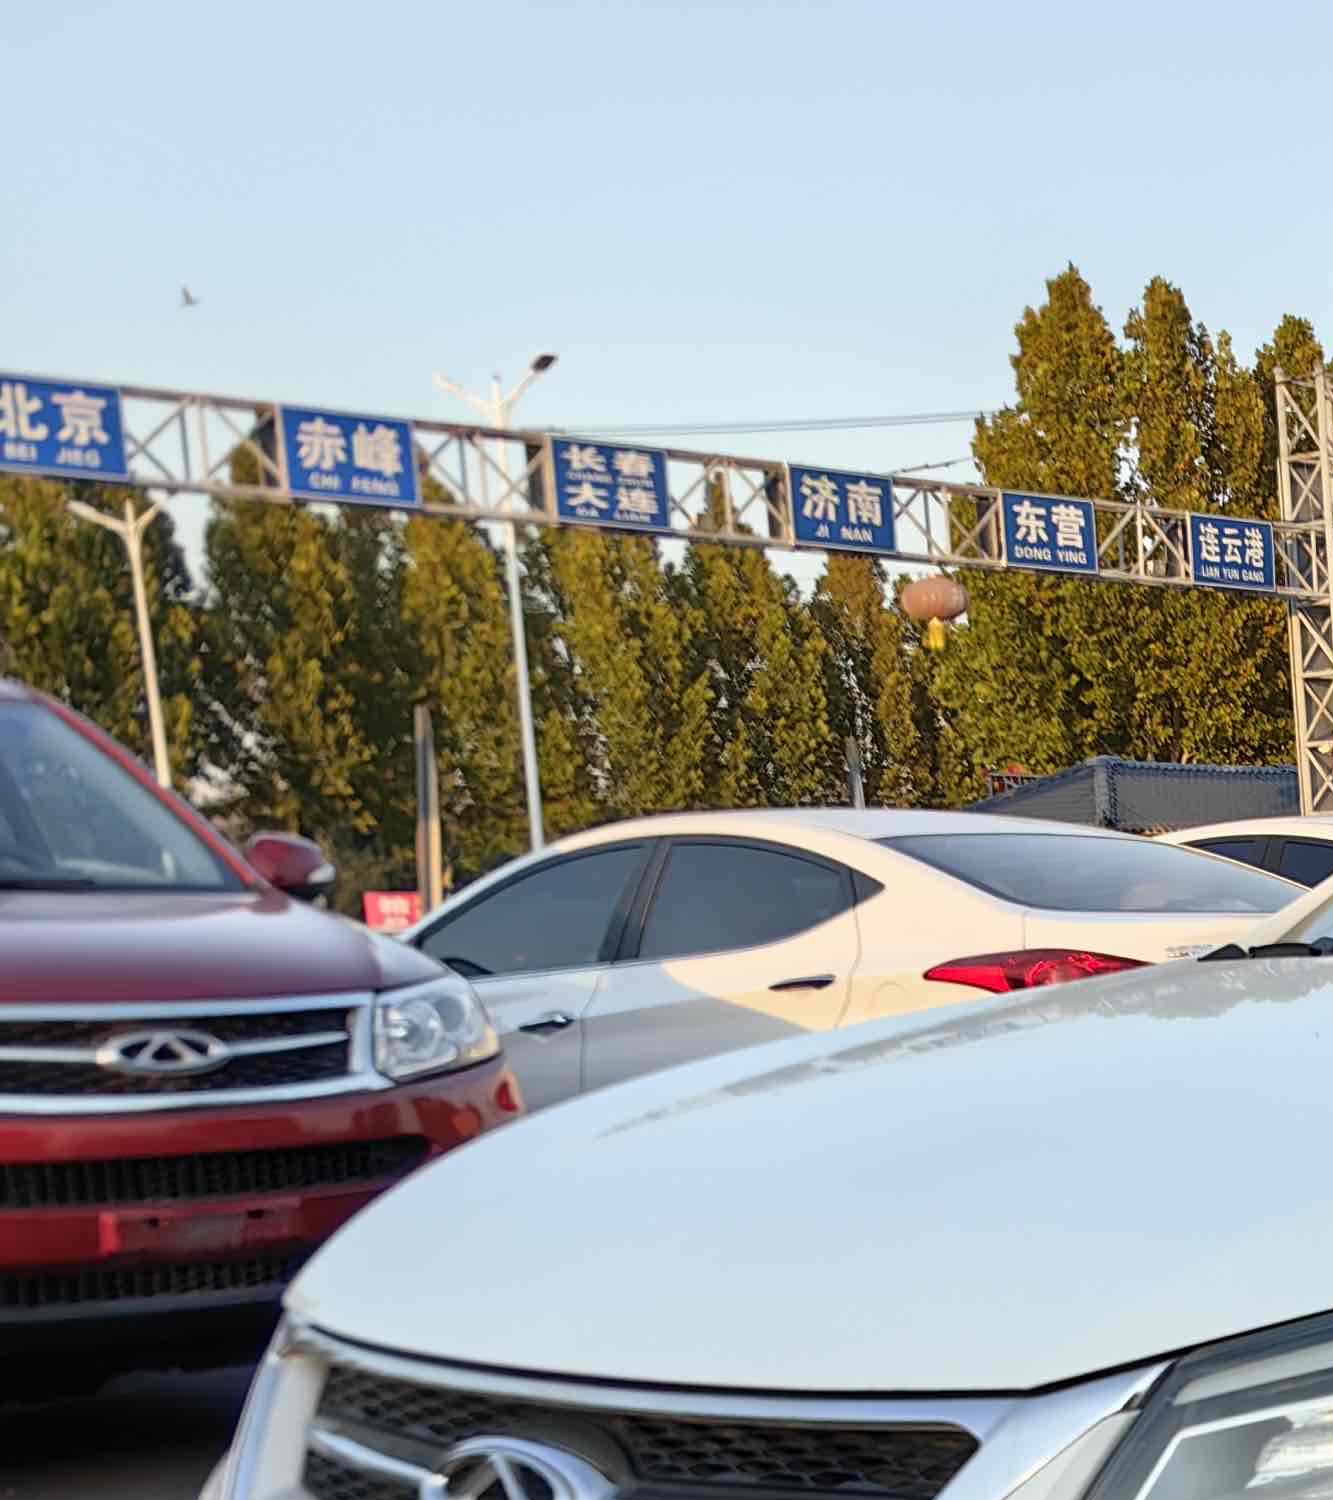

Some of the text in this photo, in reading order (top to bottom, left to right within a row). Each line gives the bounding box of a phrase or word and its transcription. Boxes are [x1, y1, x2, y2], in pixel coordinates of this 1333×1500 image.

[0, 383, 109, 446] 北京
[296, 417, 404, 475] 赤峰
[800, 474, 883, 528] 济南
[1012, 500, 1086, 549] 东营
[1014, 545, 1088, 565] DONG YING
[1198, 522, 1265, 569] 连云港
